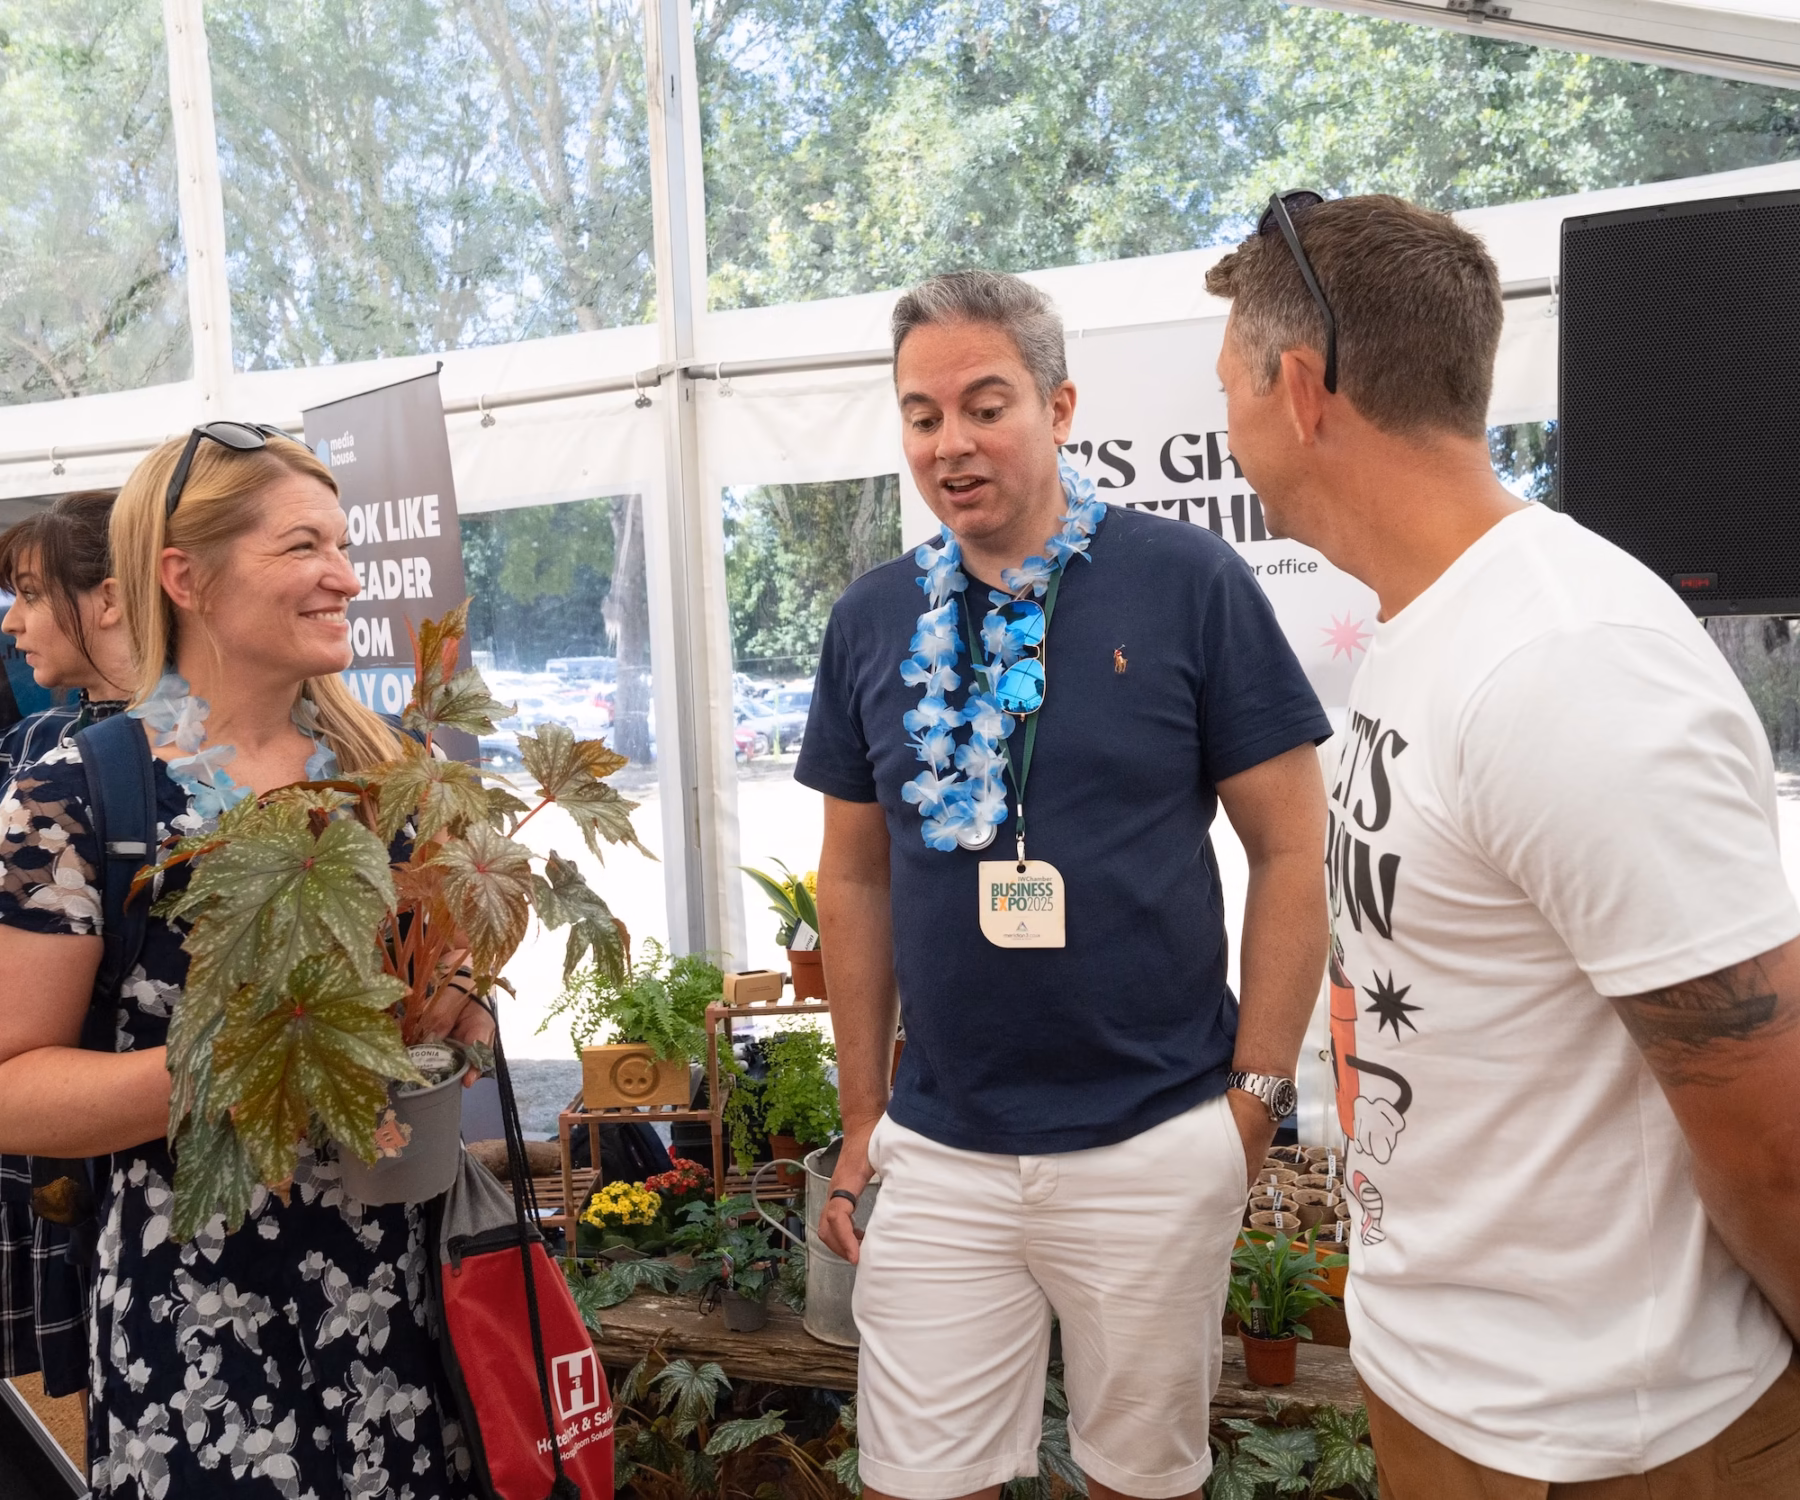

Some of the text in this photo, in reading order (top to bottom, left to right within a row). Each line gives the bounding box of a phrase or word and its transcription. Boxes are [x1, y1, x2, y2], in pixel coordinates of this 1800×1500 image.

[330, 430, 354, 451] media
[331, 451, 357, 467] house.
[1160, 431, 1245, 484] GR
[348, 494, 441, 546] OK LIKE
[351, 557, 433, 601] EADER
[1266, 559, 1318, 575] office
[349, 617, 394, 657] OM
[349, 673, 416, 714] AY ON
[991, 882, 1054, 897] BUSINESS
[582, 1416, 592, 1432] &
